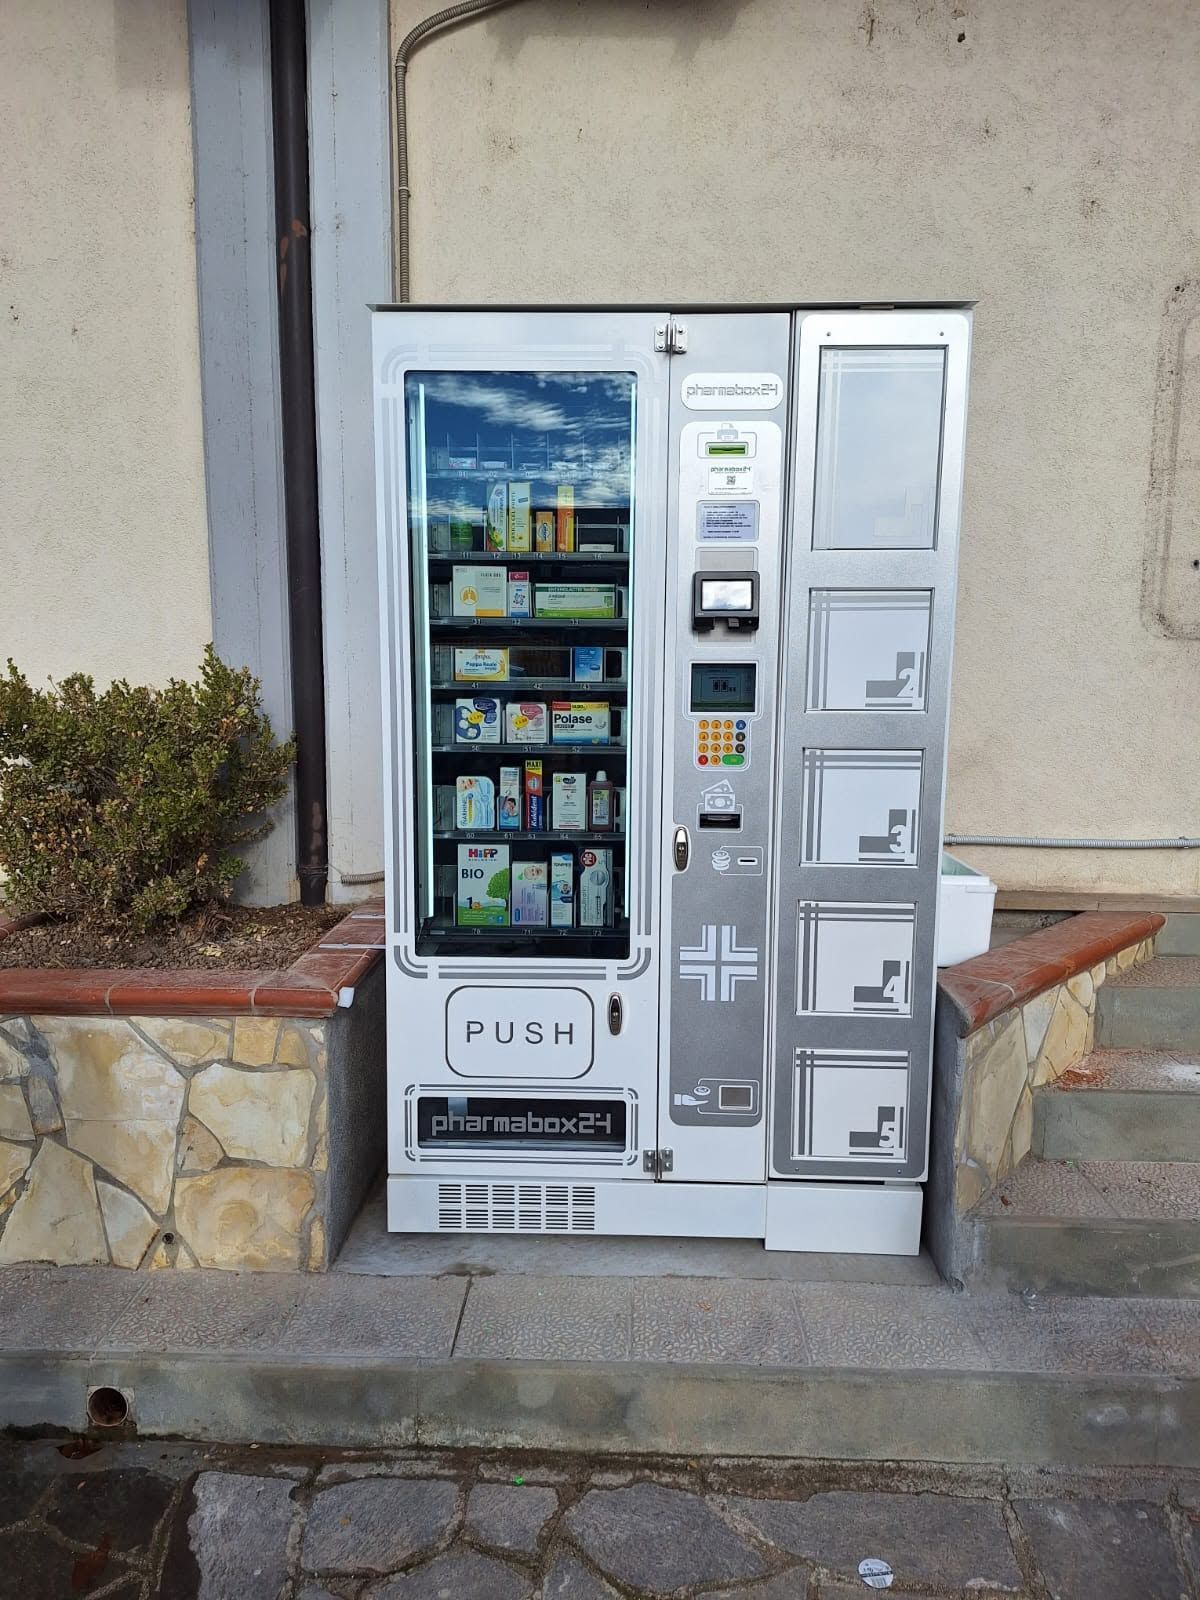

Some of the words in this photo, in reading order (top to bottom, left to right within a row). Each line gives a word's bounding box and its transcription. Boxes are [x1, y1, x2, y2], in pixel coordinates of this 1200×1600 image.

[686, 383, 778, 398] pharmabox24
[896, 667, 914, 697] 2
[554, 713, 593, 724] Polase
[889, 824, 907, 853] 3
[468, 848, 498, 858] HiPP
[461, 868, 484, 879] BIO
[466, 896, 473, 909] 1
[882, 975, 900, 1002] 4
[466, 1020, 573, 1045] PUSH
[431, 1111, 612, 1136] pharmabox24
[878, 1121, 895, 1148] 5
